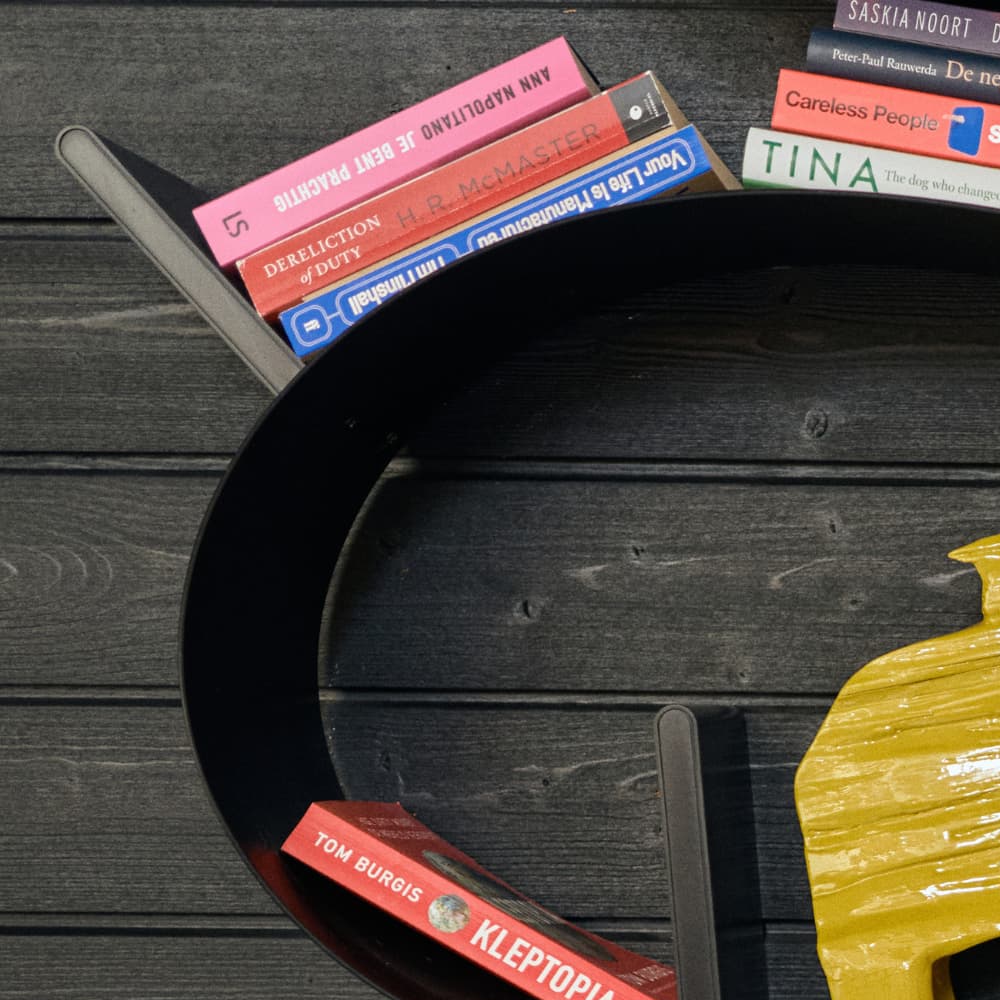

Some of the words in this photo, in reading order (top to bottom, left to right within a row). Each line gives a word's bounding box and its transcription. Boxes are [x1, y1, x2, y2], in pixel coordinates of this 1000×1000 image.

[848, 0, 909, 29] SASKIA
[914, 10, 973, 39] NOORT
[519, 66, 552, 94] ANN
[832, 48, 884, 68] Peter-Paul
[886, 57, 938, 77] Rauwerda
[945, 60, 974, 83] De
[421, 86, 517, 141] NAPOLITANO
[785, 90, 868, 120] Careless
[873, 105, 939, 132] People
[354, 142, 395, 175] BENT
[395, 131, 416, 153] JE
[608, 165, 646, 194] Life
[762, 139, 879, 193] TINA
[884, 168, 907, 185] The
[908, 172, 930, 192] dog
[932, 177, 956, 194] who
[273, 163, 351, 212] PRACHTIG
[263, 214, 382, 278] DERELICTION
[301, 265, 314, 285] of
[315, 245, 362, 276] DUTY
[313, 831, 353, 863] TOM
[354, 855, 424, 903] BURGIS
